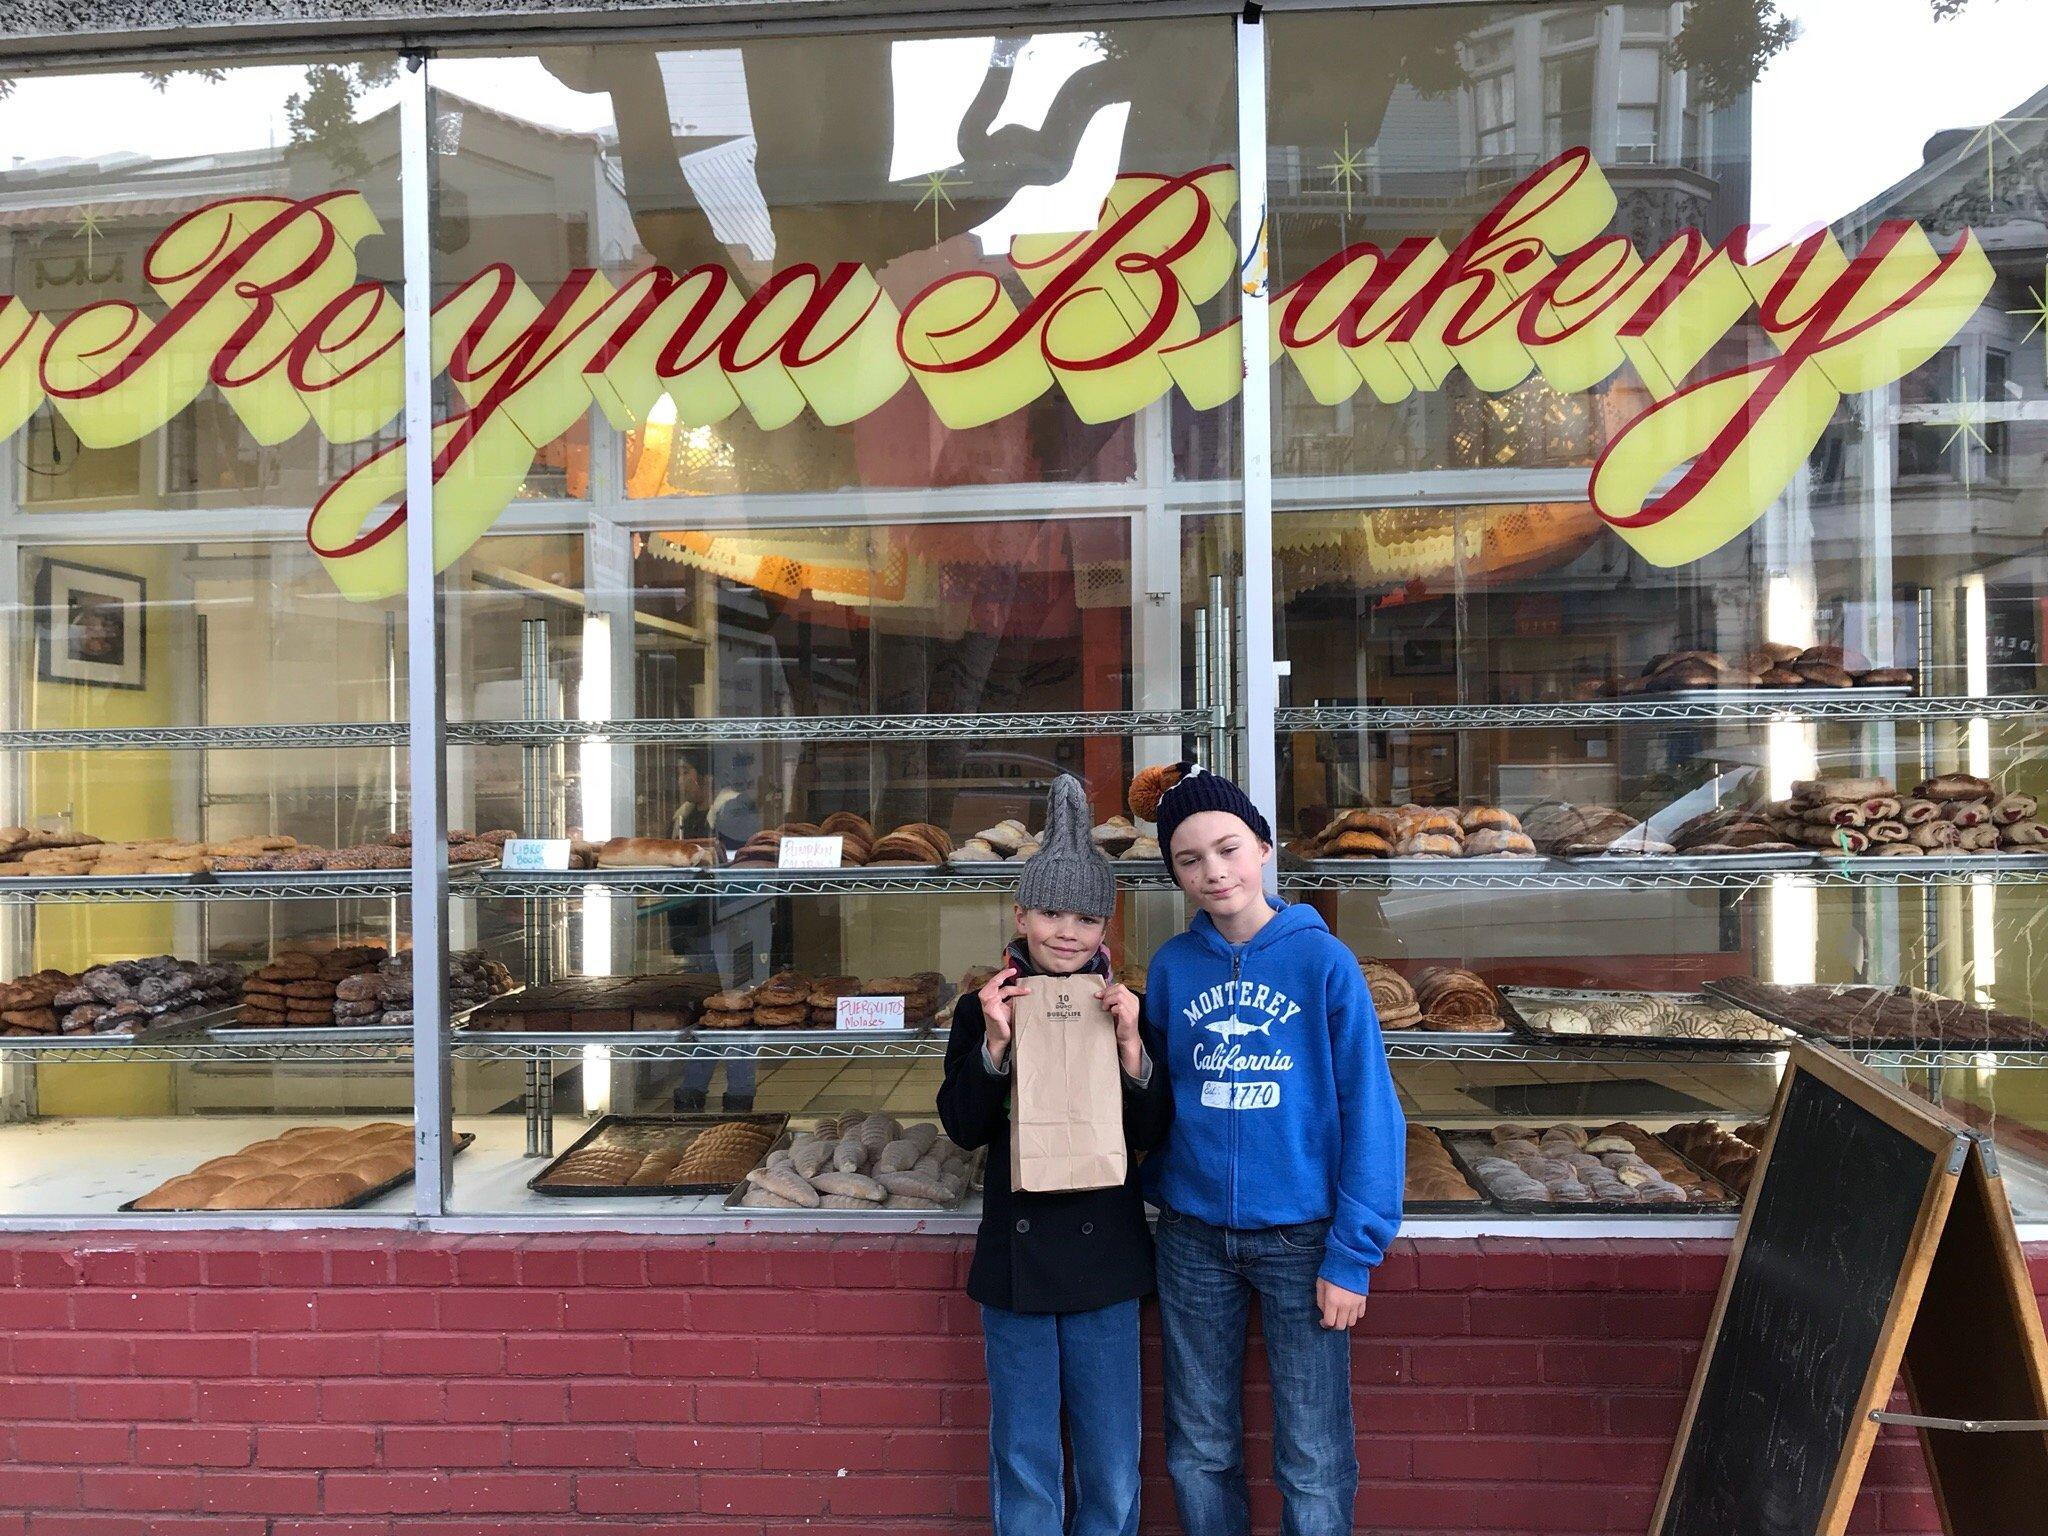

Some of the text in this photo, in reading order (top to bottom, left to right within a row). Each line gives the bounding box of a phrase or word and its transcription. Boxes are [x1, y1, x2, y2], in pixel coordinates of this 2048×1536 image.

[40, 146, 1984, 580] Reyna Bakery
[1059, 994, 1070, 1002] 10
[1183, 980, 1301, 1027] MONTEREY
[1193, 1042, 1294, 1078] California
[1229, 1084, 1274, 1107] 1770
